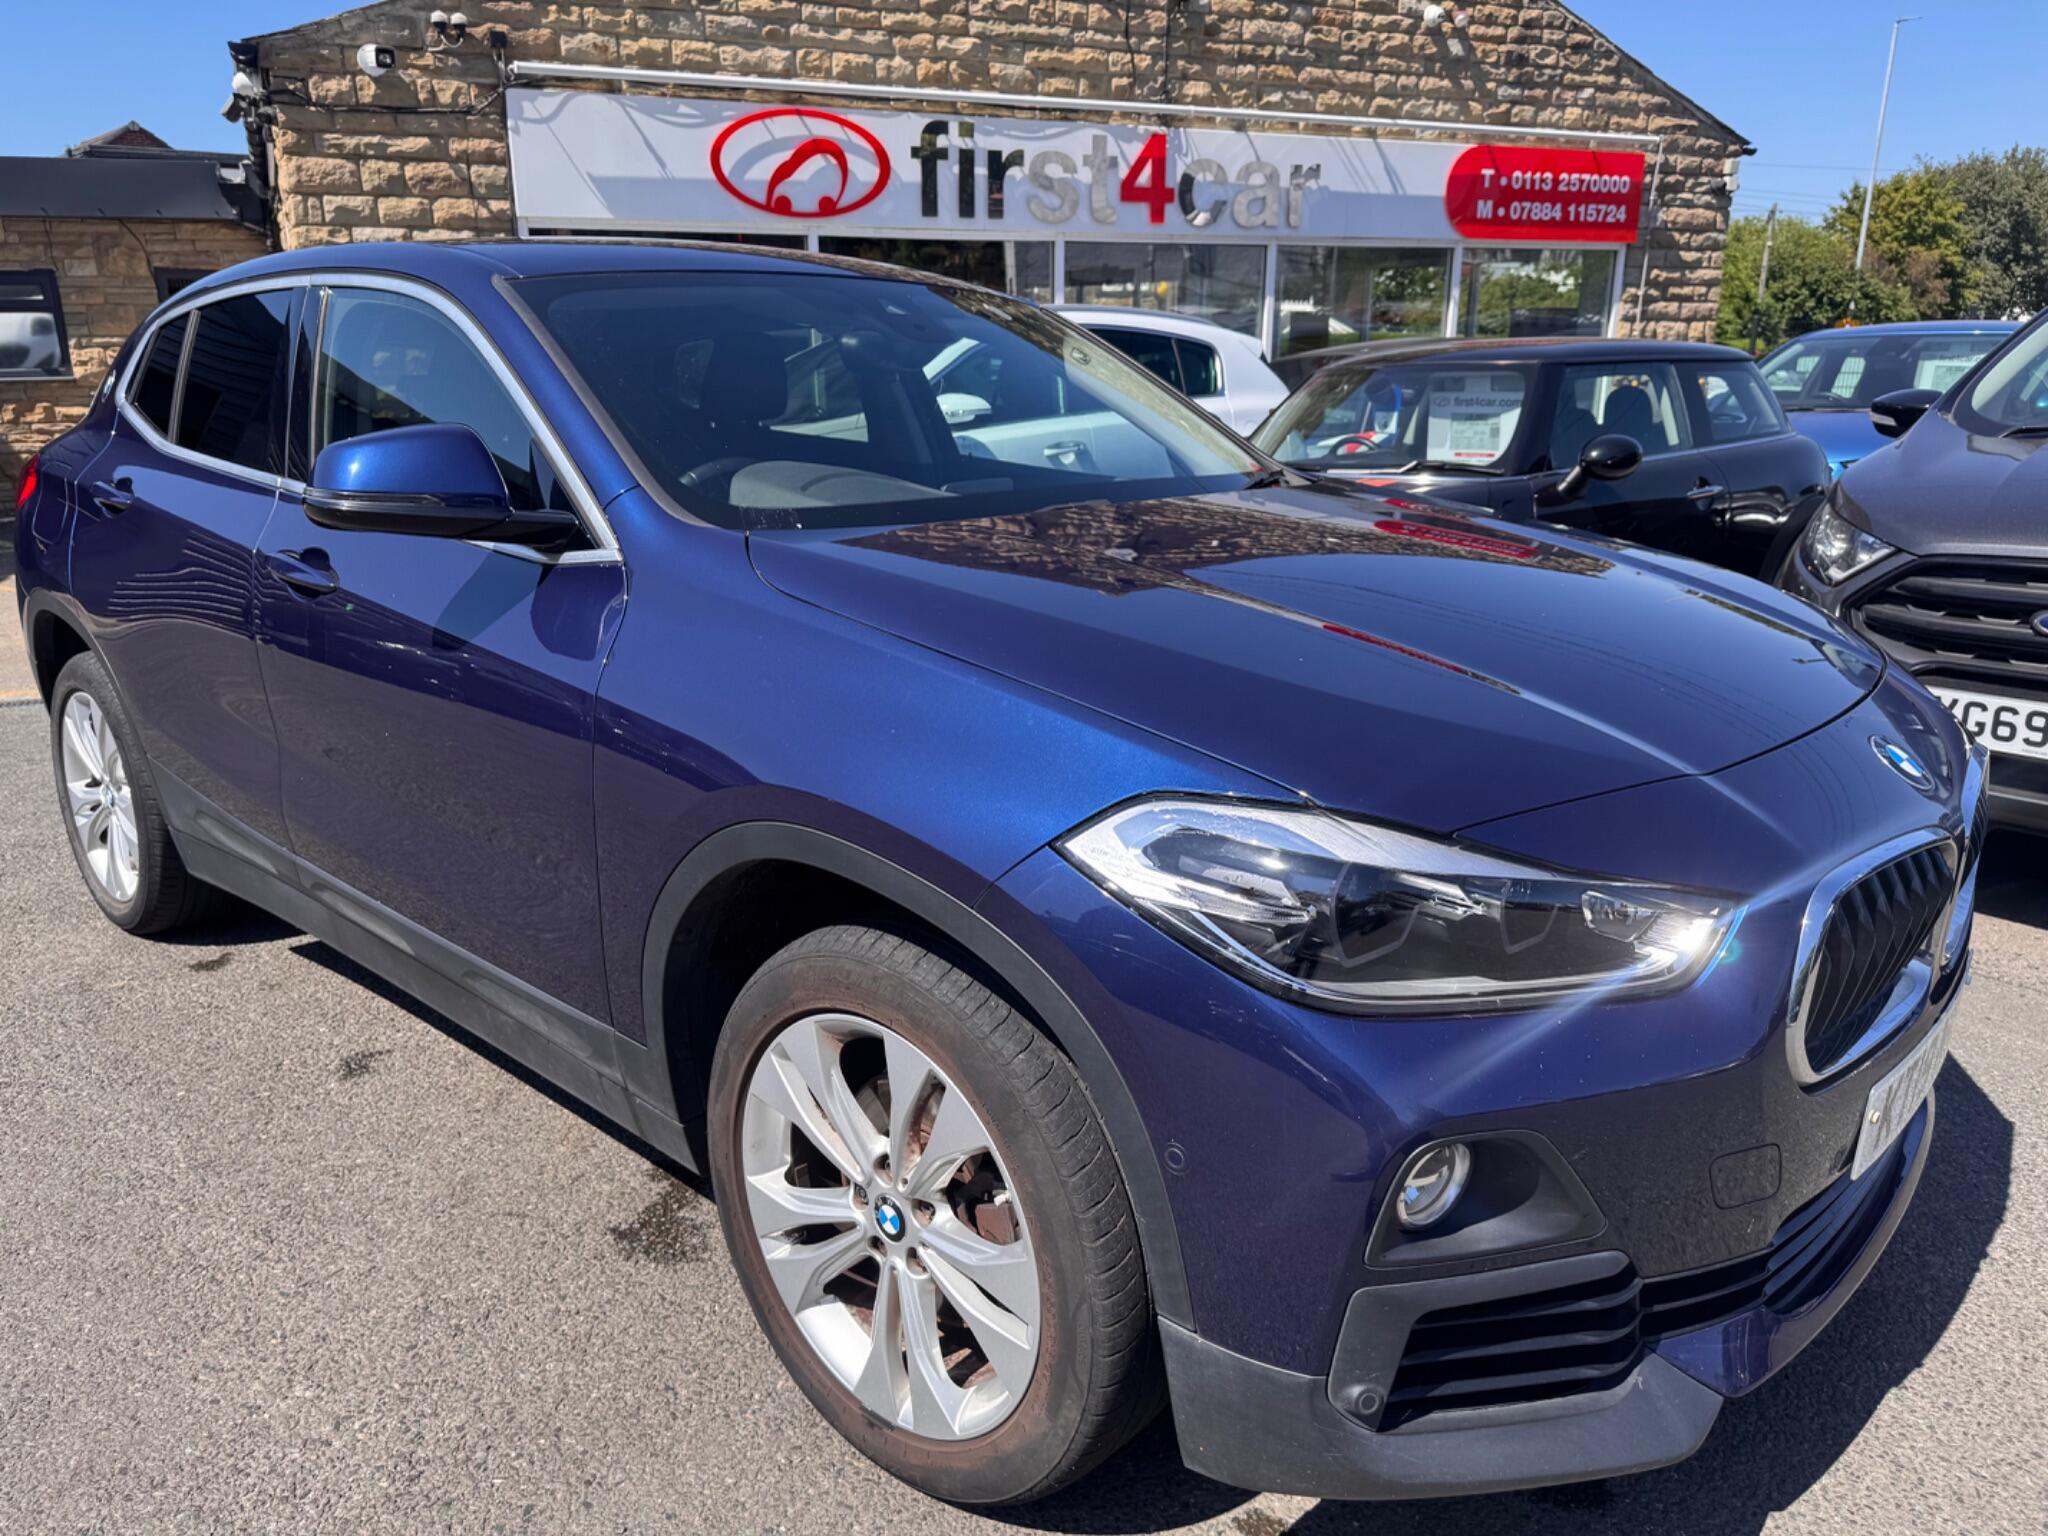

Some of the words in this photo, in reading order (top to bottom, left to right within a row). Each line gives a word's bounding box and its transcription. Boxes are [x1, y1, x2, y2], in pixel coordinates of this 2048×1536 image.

[910, 119, 1322, 229] first4car
[1481, 169, 1495, 188] T
[1511, 170, 1553, 191] 0113
[1558, 173, 1630, 193] 2570000
[1476, 200, 1493, 219] M
[1510, 201, 1562, 221] 07884
[1568, 203, 1626, 222] 115724
